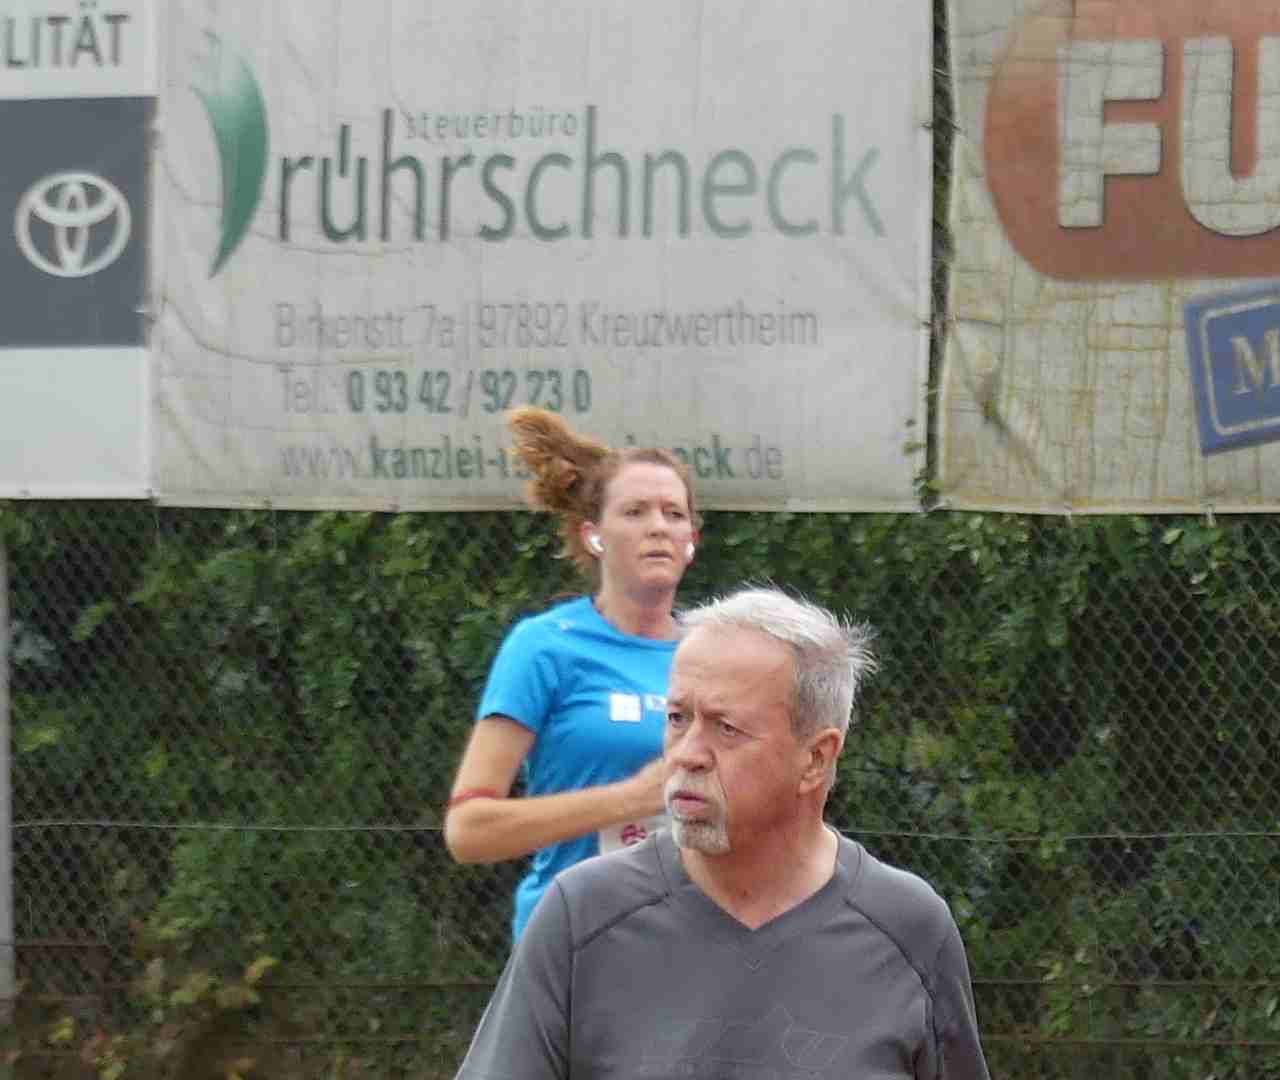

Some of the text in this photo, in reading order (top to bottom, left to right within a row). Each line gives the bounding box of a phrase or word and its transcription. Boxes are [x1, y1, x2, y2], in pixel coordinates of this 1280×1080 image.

[406, 104, 579, 141] steuerbüro
[479, 302, 570, 349] 97892
[580, 299, 818, 349] Kreuzwertheim
